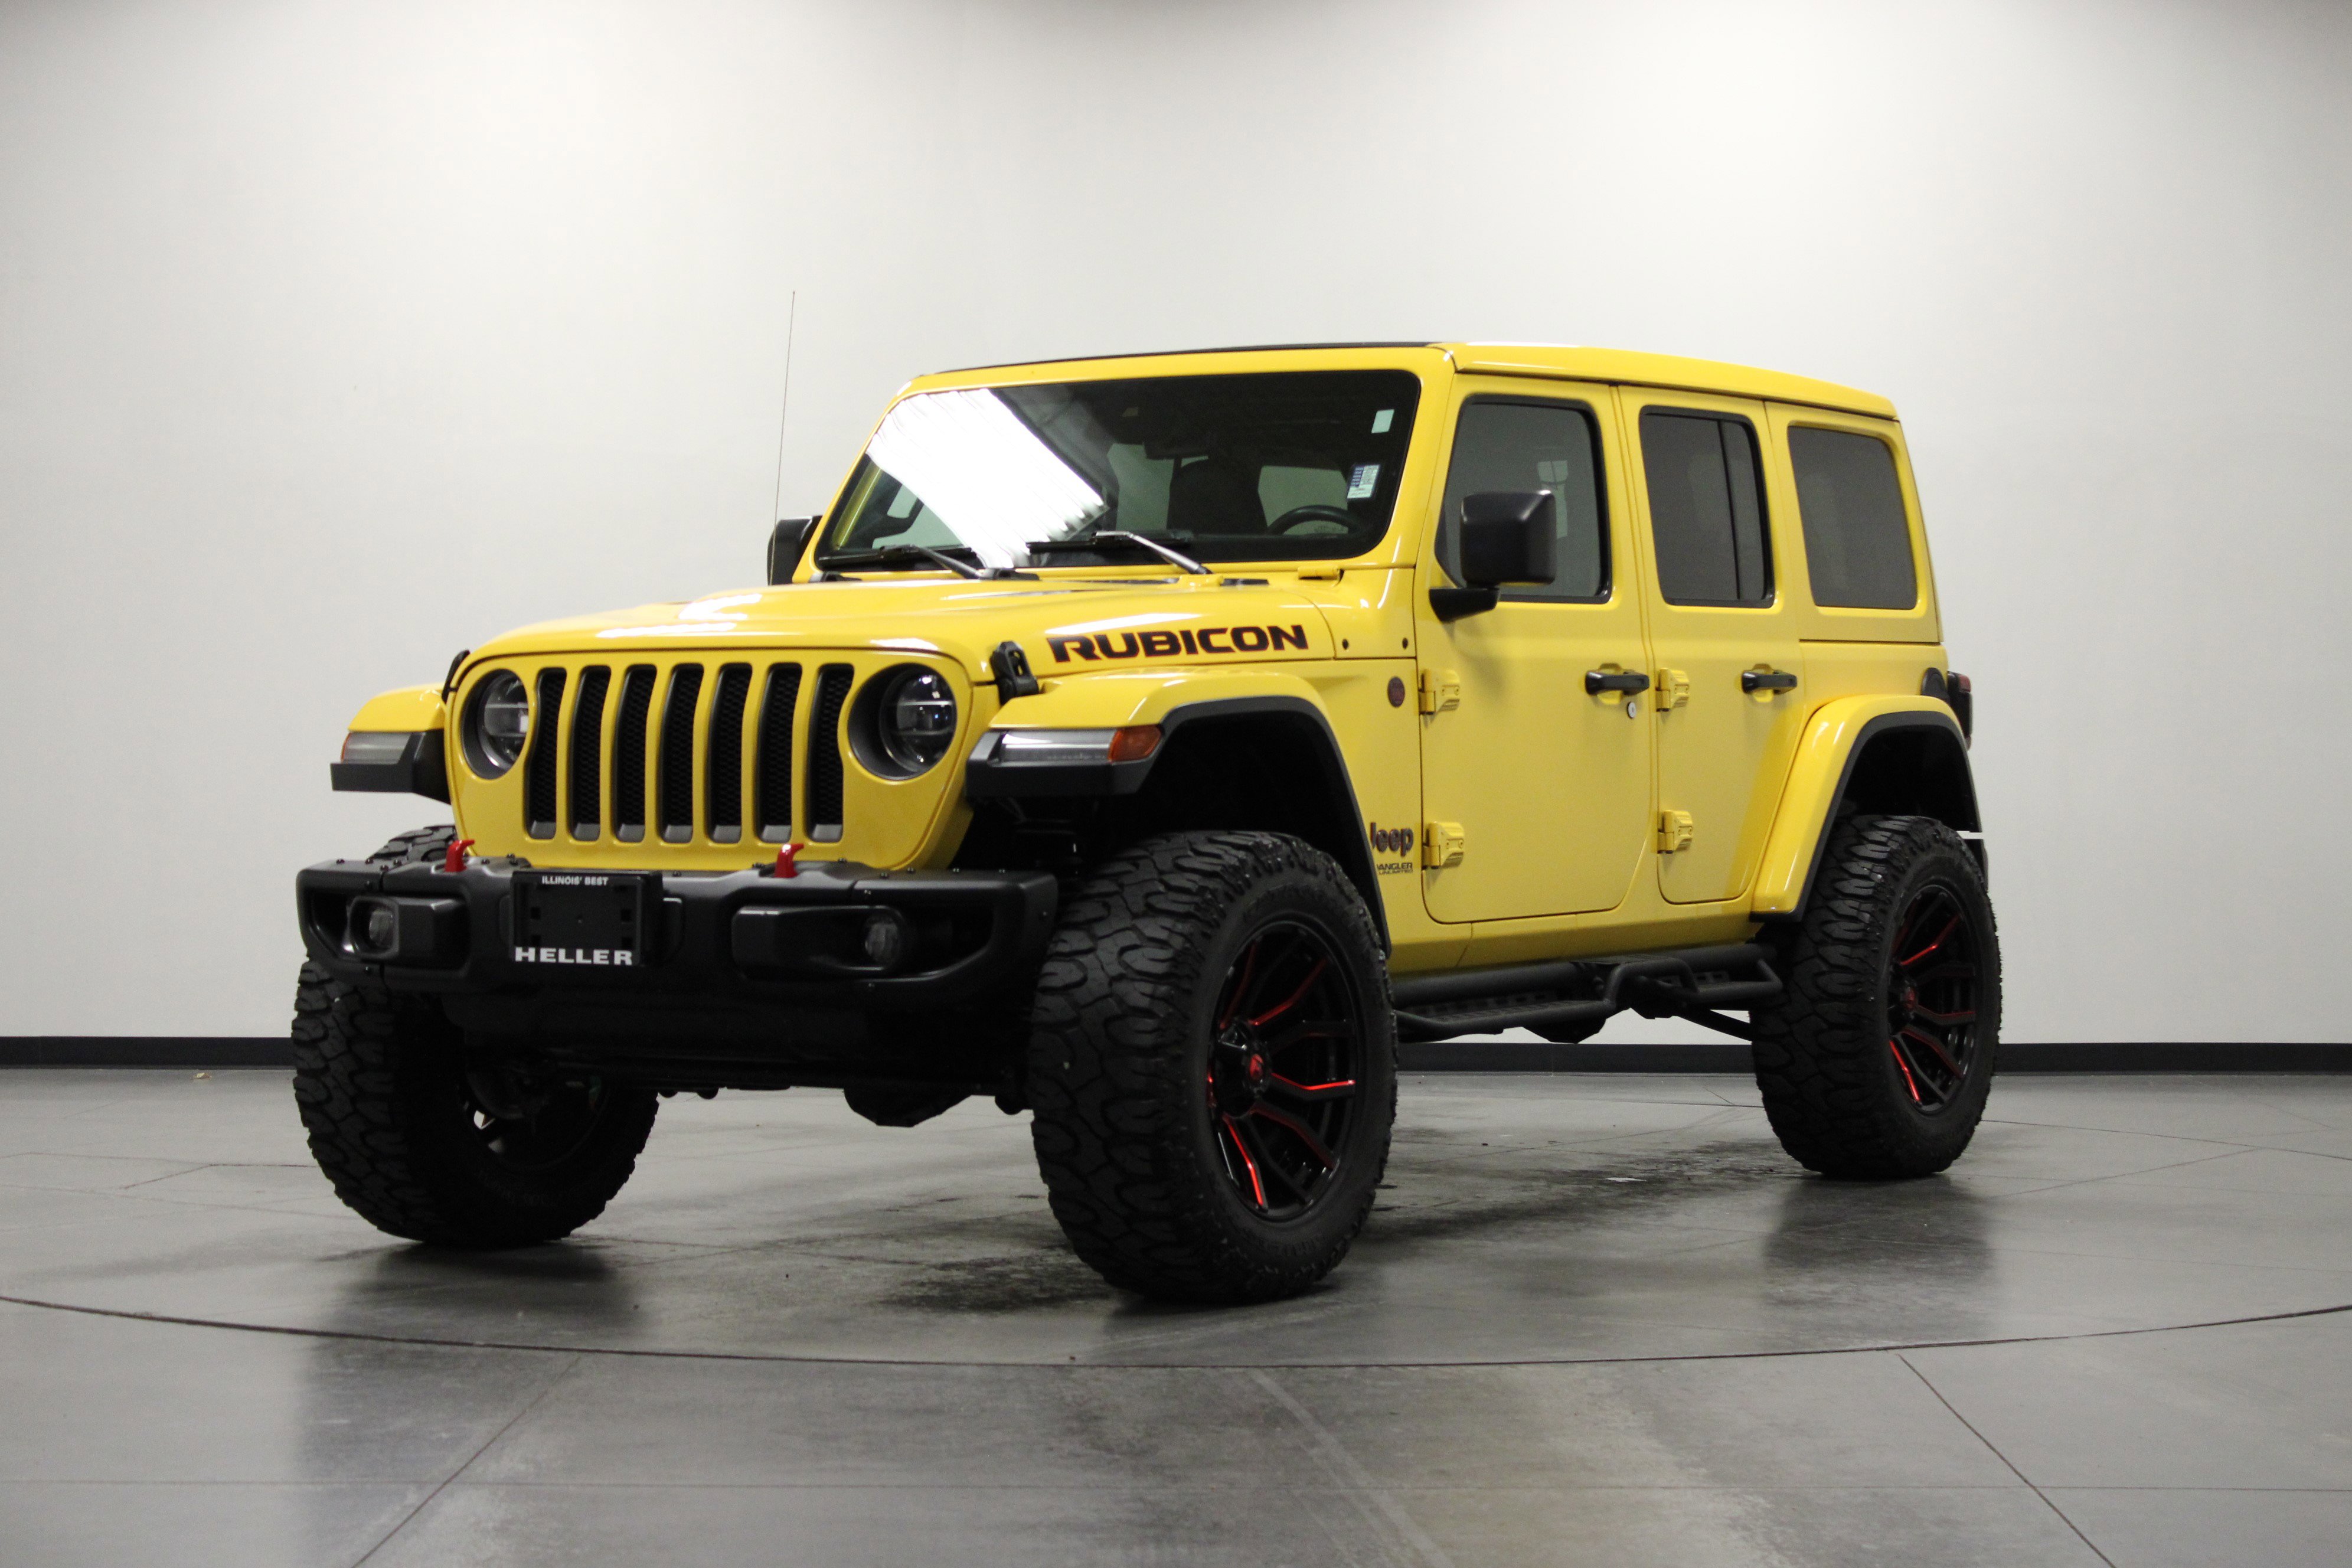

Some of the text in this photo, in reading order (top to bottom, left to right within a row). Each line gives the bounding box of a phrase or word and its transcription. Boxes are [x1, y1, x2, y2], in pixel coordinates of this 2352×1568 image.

[1046, 625, 1309, 662] RUBICON
[1376, 863, 1413, 871] ANGLER
[584, 876, 609, 886] BEST
[515, 946, 633, 966] HELLER
